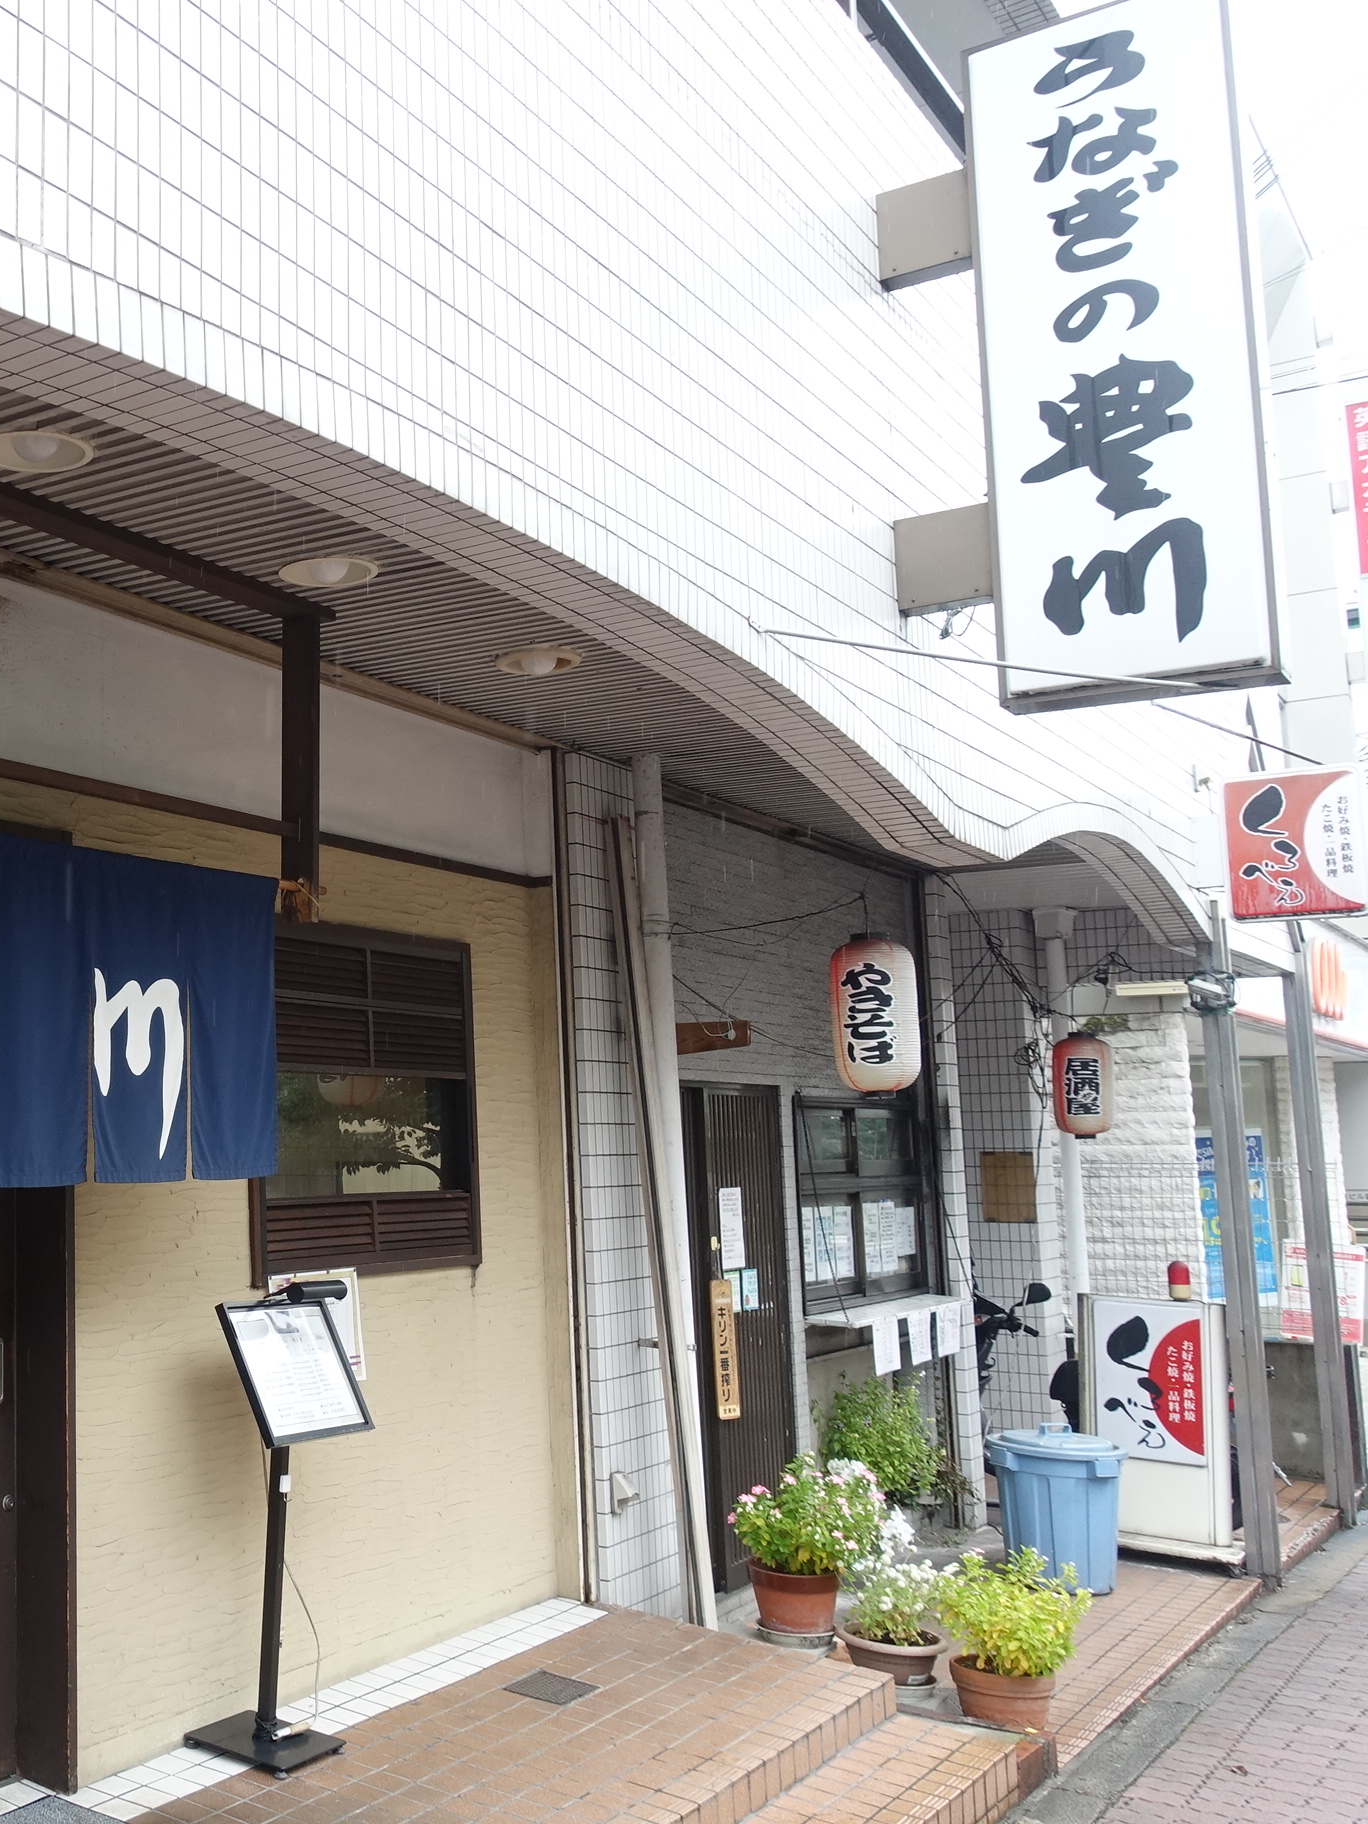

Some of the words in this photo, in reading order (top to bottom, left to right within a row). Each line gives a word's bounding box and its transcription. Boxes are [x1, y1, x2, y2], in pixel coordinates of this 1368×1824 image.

[1021, 30, 1207, 642] うなぎの豊川
[1063, 1056, 1101, 1116] 居酒屋
[717, 1306, 731, 1403] キリン一番搾り
[1166, 1345, 1181, 1423] たこ焼・一品料理
[1181, 1340, 1196, 1422] お好み焼・鉄板焼
